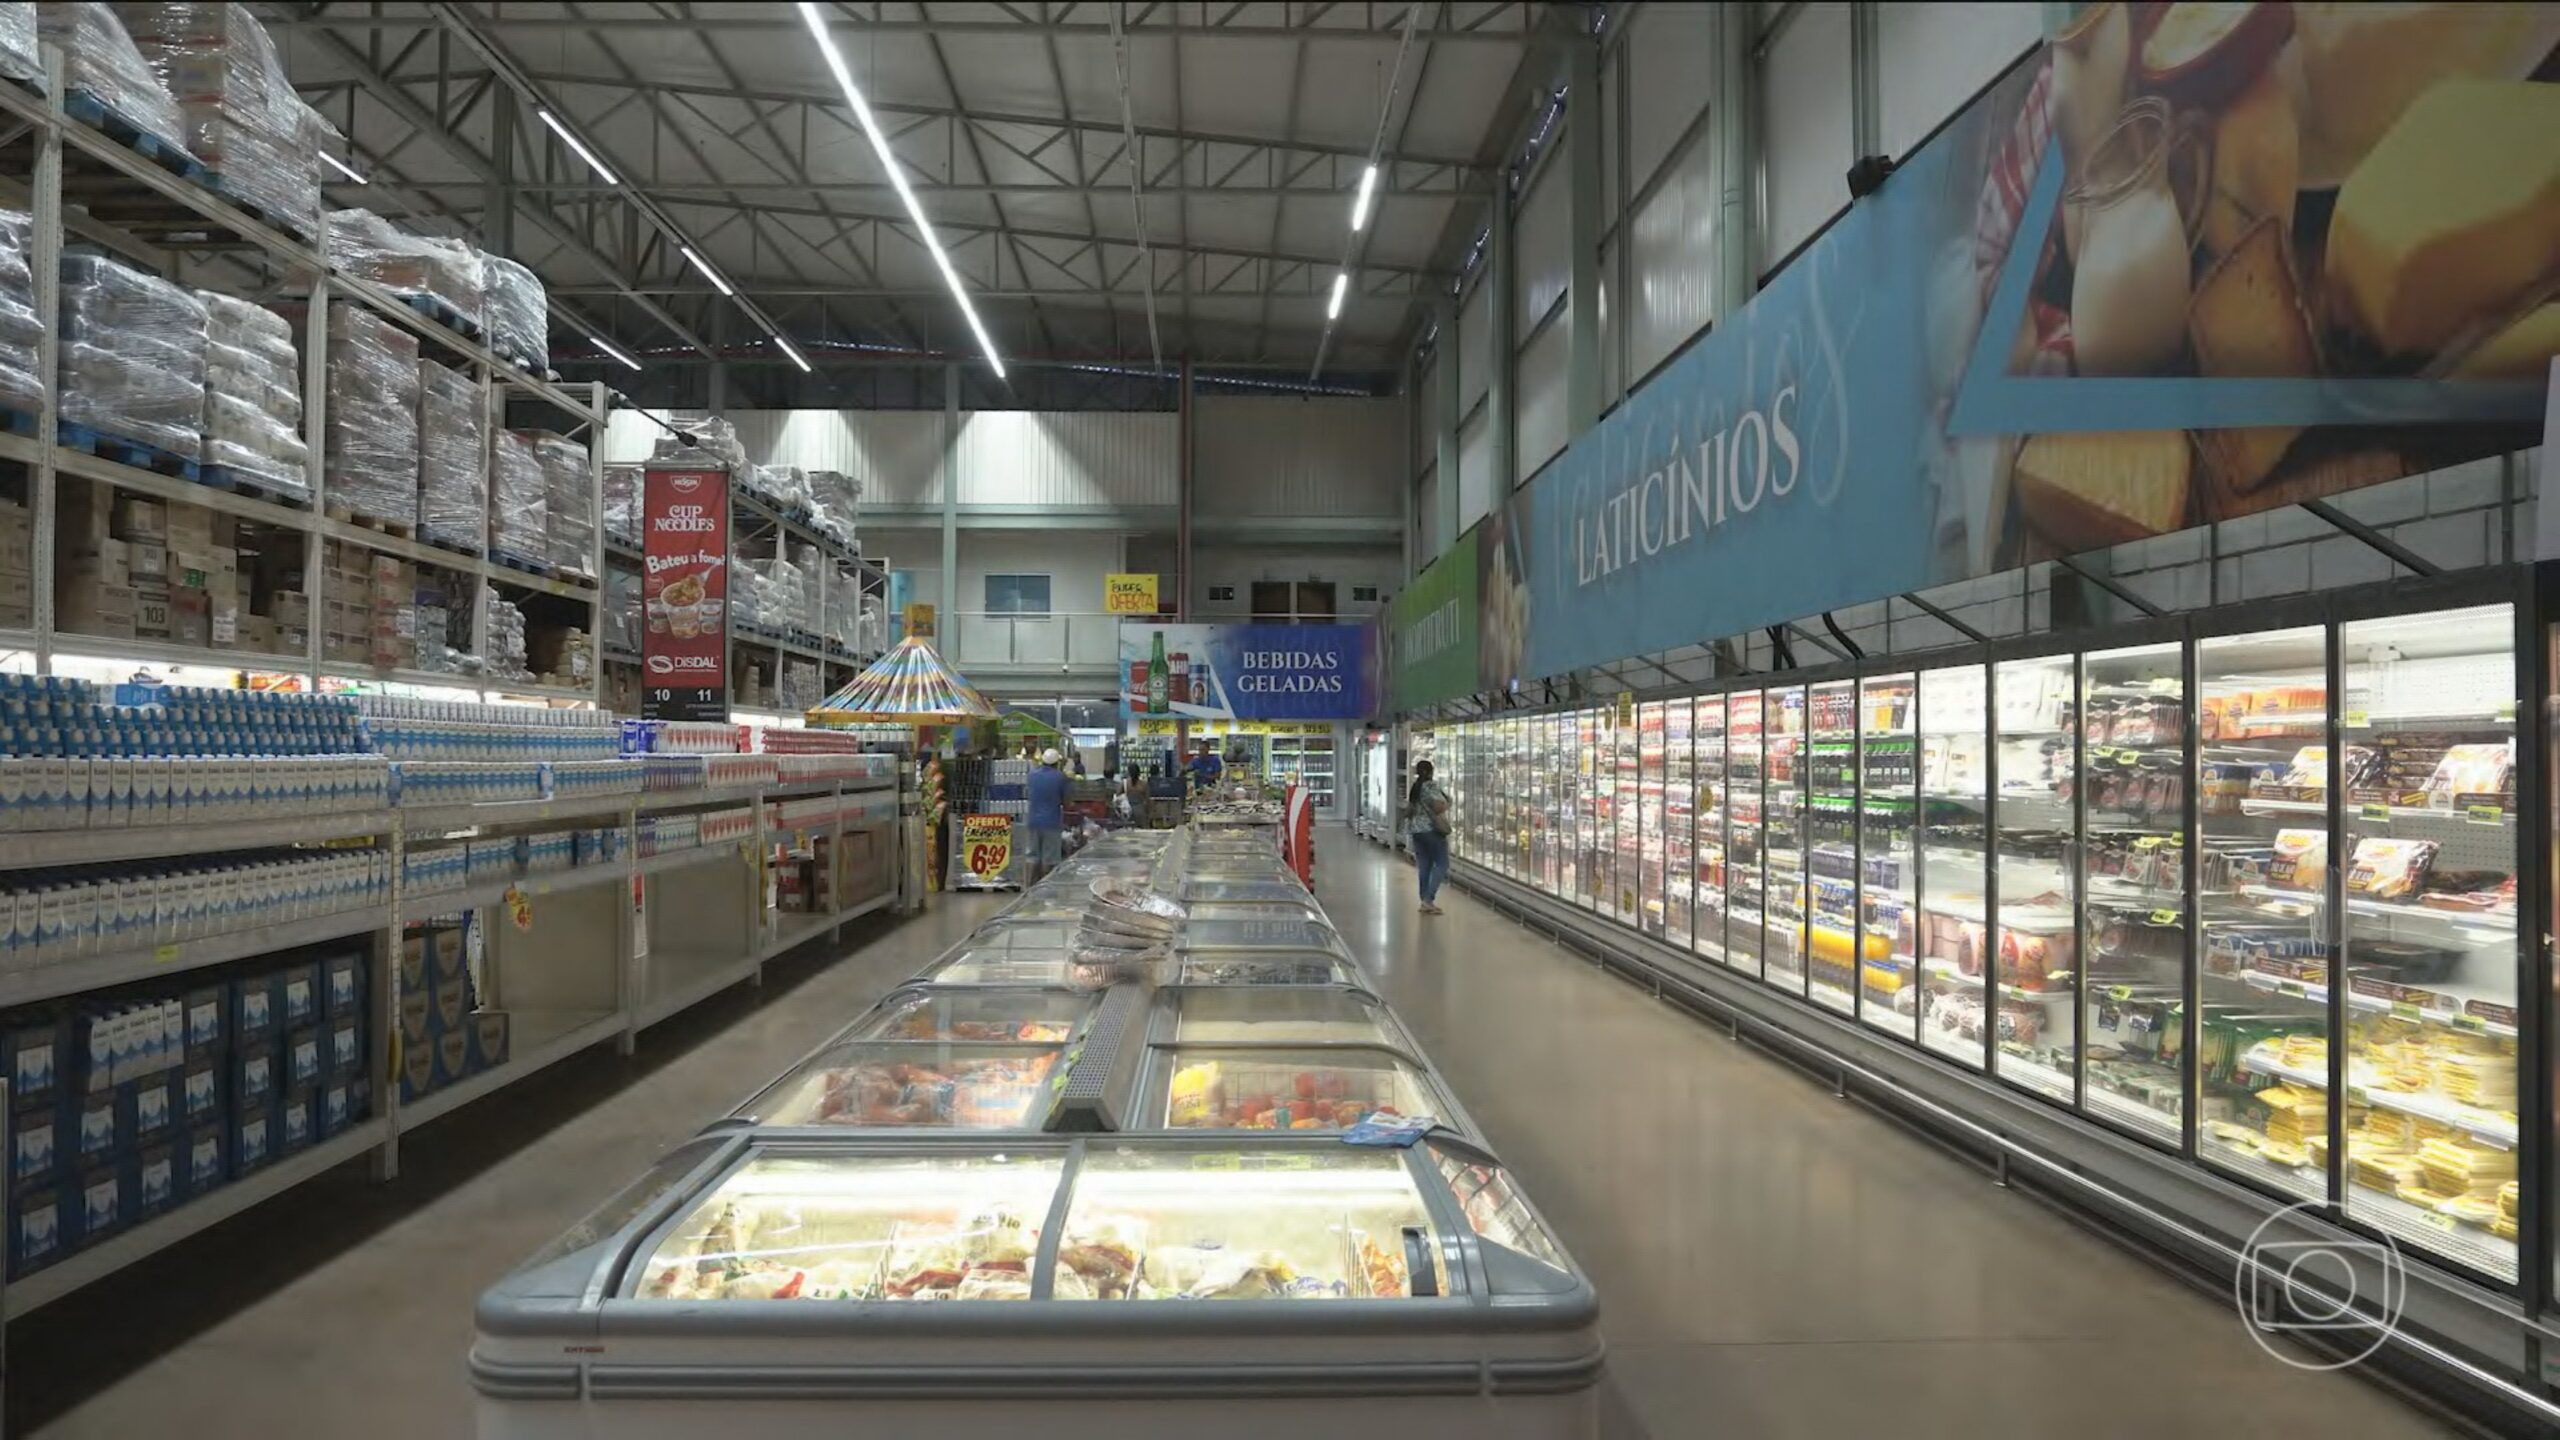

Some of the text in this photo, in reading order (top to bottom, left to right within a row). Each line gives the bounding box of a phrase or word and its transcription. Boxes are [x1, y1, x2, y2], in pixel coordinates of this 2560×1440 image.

[1579, 384, 1799, 587] LATICÍNIOS
[669, 505, 703, 518] CUP
[654, 518, 715, 532] NOODLES
[645, 554, 689, 574] Bateu
[144, 607, 166, 624] 103
[1243, 652, 1338, 670] BEBIDAS
[1237, 675, 1342, 693] GELADAS
[654, 689, 671, 701] 10
[697, 689, 712, 701] 11
[966, 817, 1008, 827] OFERTA
